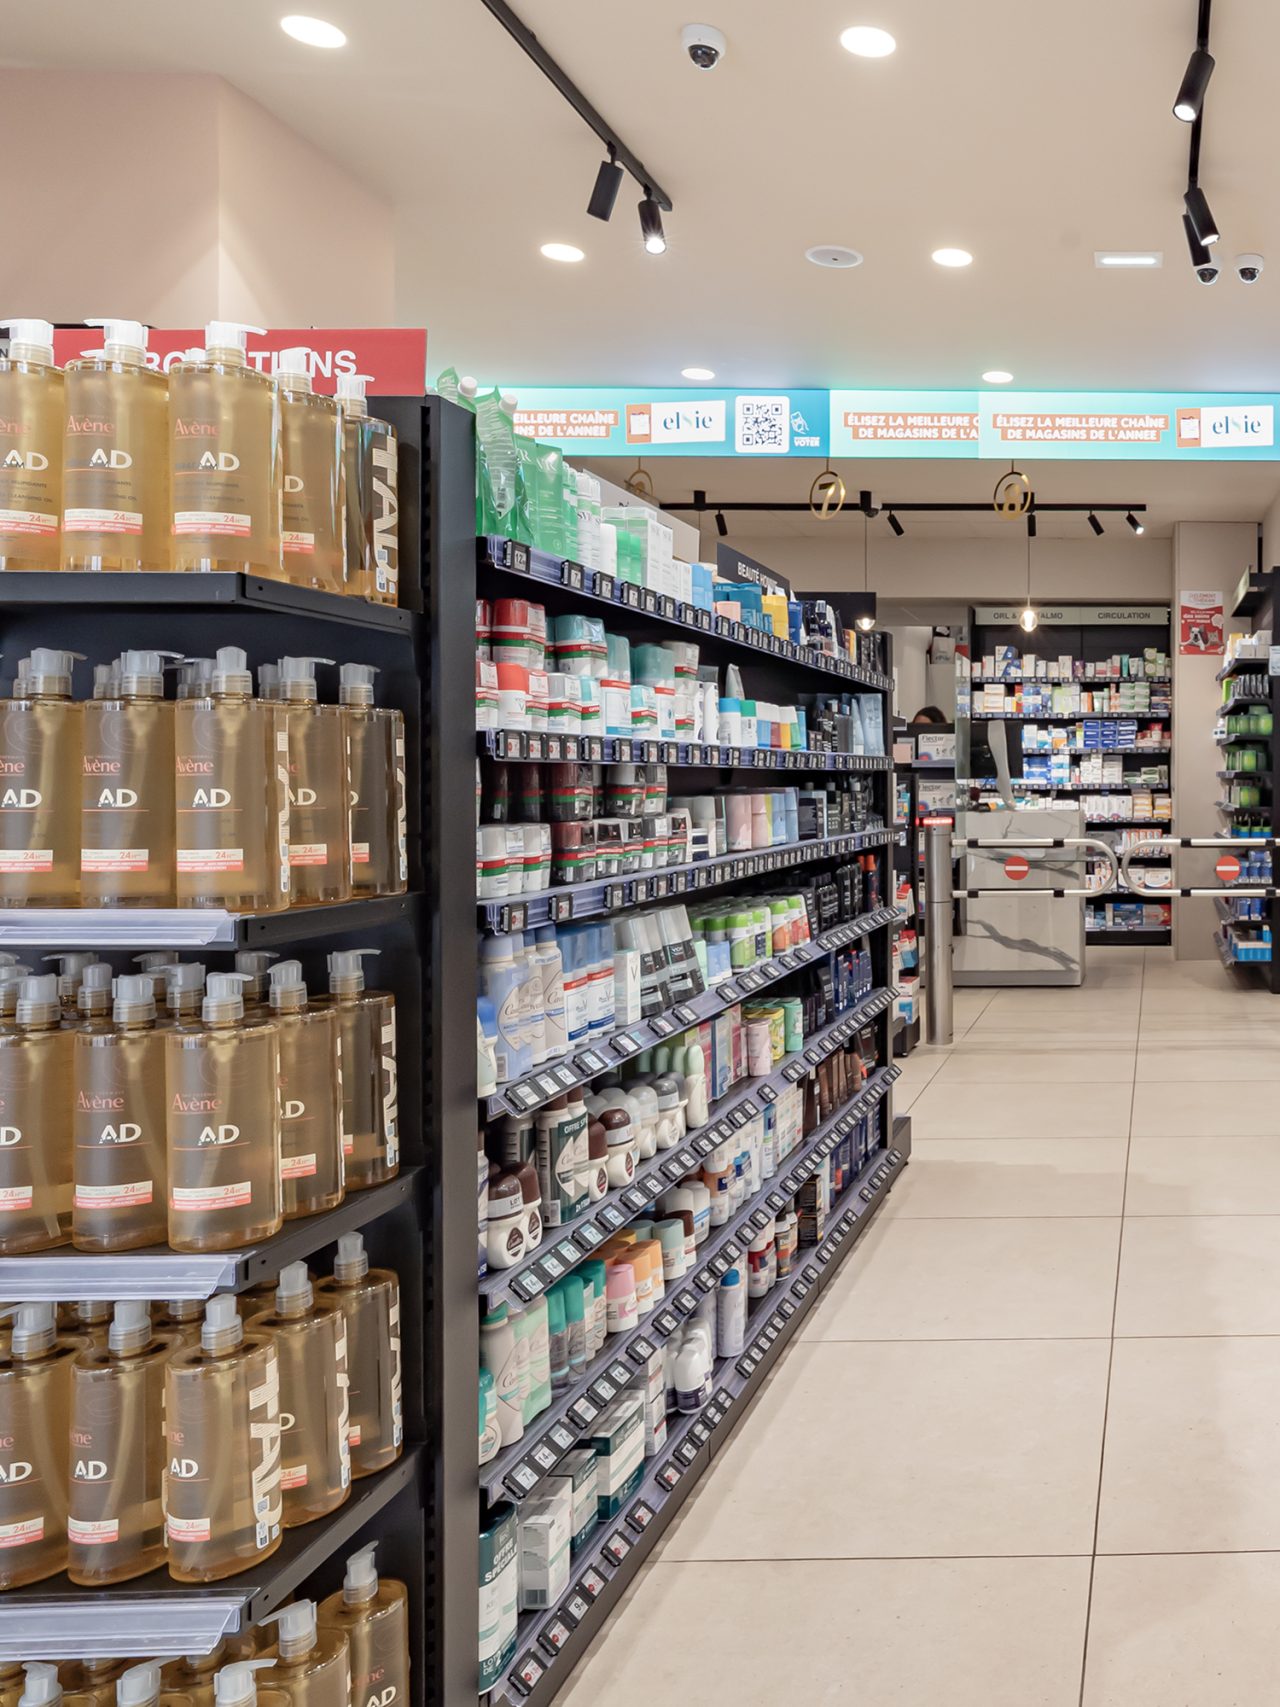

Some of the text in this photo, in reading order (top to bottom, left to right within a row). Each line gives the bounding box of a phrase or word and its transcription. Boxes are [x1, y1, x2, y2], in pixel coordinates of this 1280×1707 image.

[67, 415, 115, 434] Avène
[513, 412, 567, 425] EILLEURE
[848, 414, 971, 427] ÉLISEZ LA MEILLEURE
[996, 415, 1166, 428] ÉLISEZ LA MEILLEURE CHAÎNE
[858, 428, 874, 438] DE
[877, 428, 939, 439] MAGASINS
[942, 429, 957, 439] DE
[1007, 430, 1022, 440] DE
[1025, 430, 1087, 440] MAGASINS
[1090, 430, 1105, 440] DE
[1097, 612, 1151, 620] CIRCULATION
